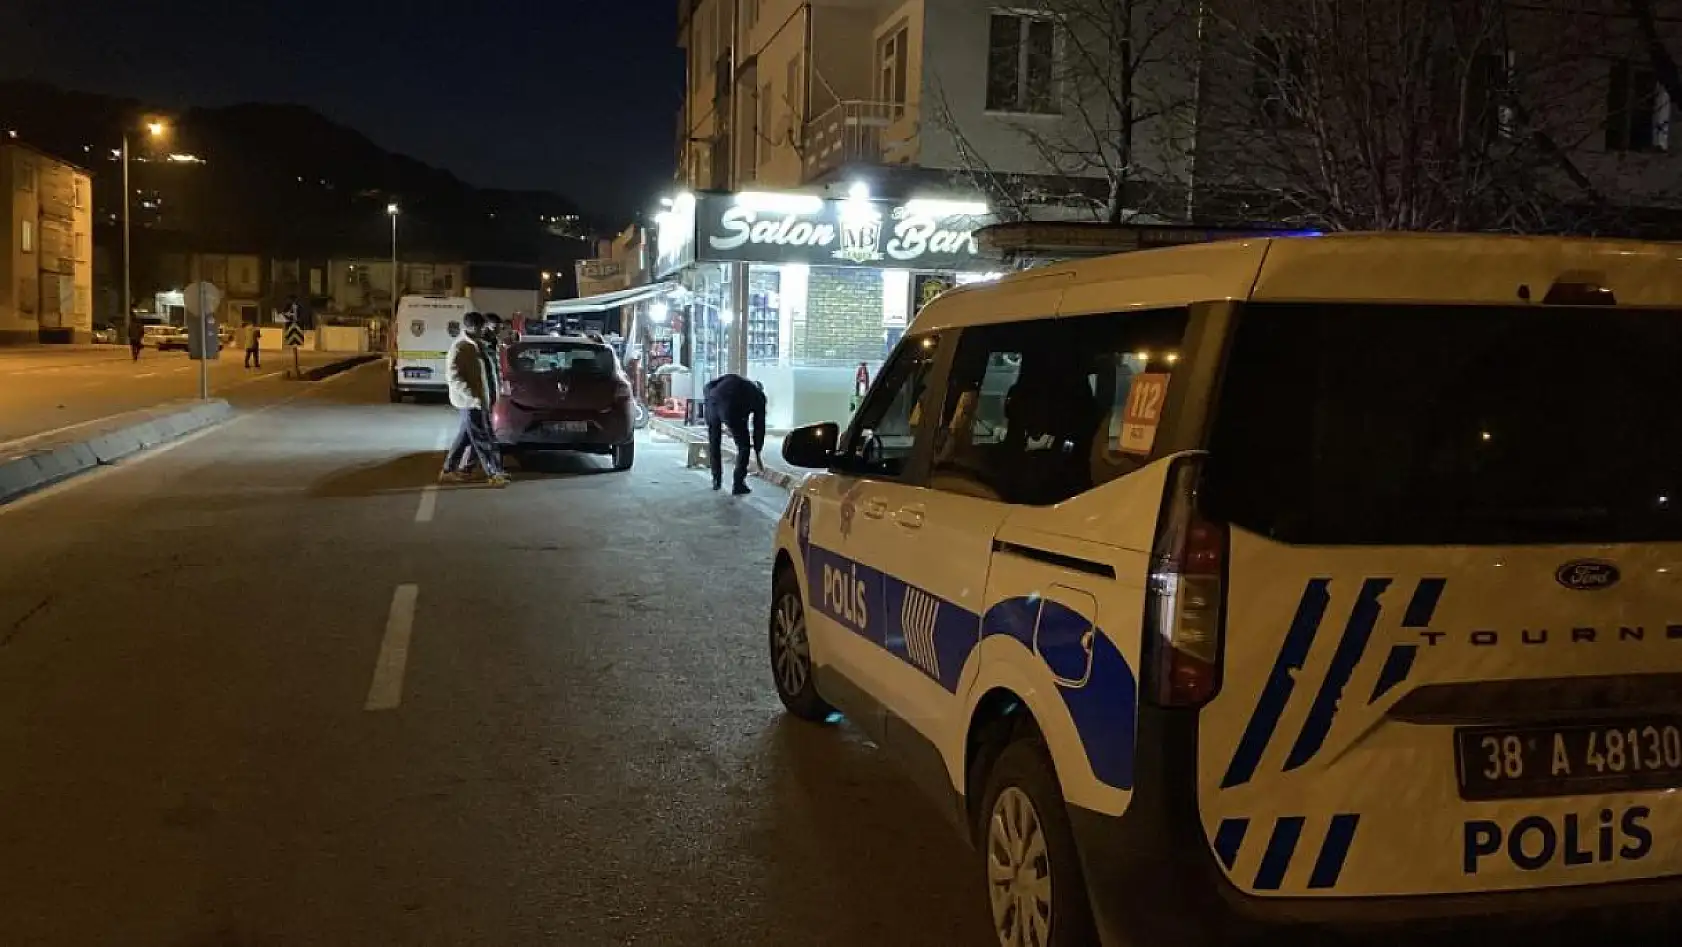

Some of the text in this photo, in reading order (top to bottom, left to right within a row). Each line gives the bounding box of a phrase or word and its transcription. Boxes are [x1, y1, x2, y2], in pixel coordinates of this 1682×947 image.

[710, 205, 835, 249] Salon
[1131, 382, 1161, 418] 112
[1571, 564, 1609, 587] Ford
[1481, 725, 1681, 780] 38 A 48130
